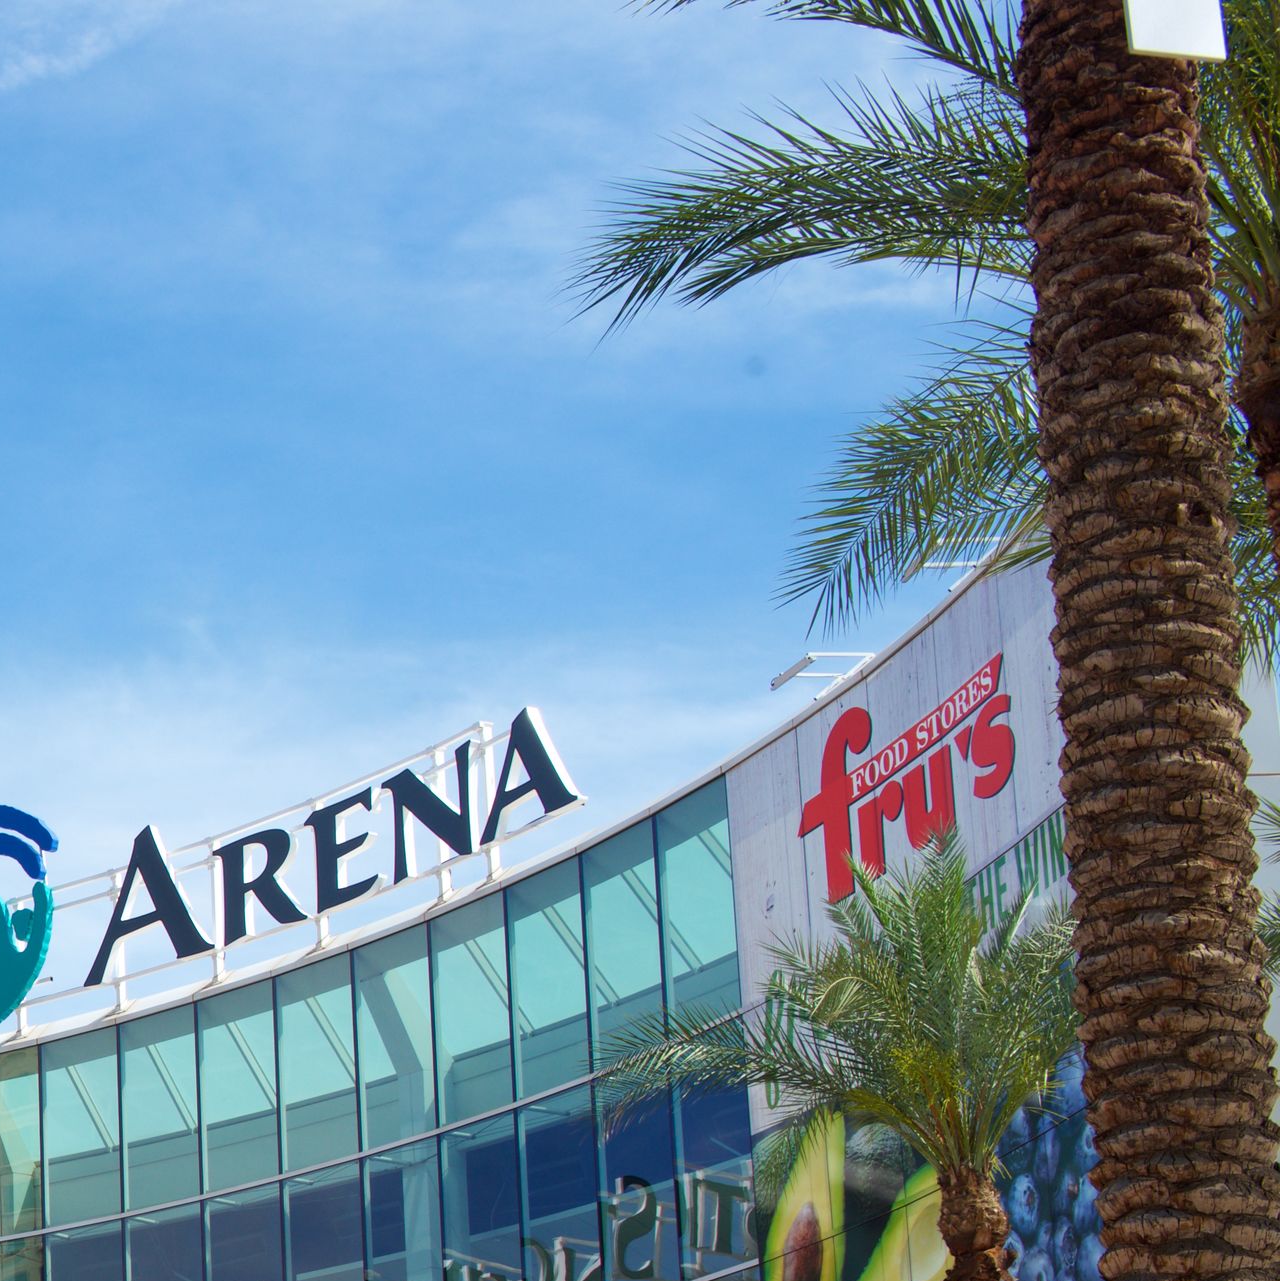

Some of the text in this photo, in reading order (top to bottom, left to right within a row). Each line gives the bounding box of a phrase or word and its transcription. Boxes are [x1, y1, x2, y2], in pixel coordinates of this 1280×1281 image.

[849, 664, 993, 798] FOOD STORES
[83, 706, 587, 987] ARENA
